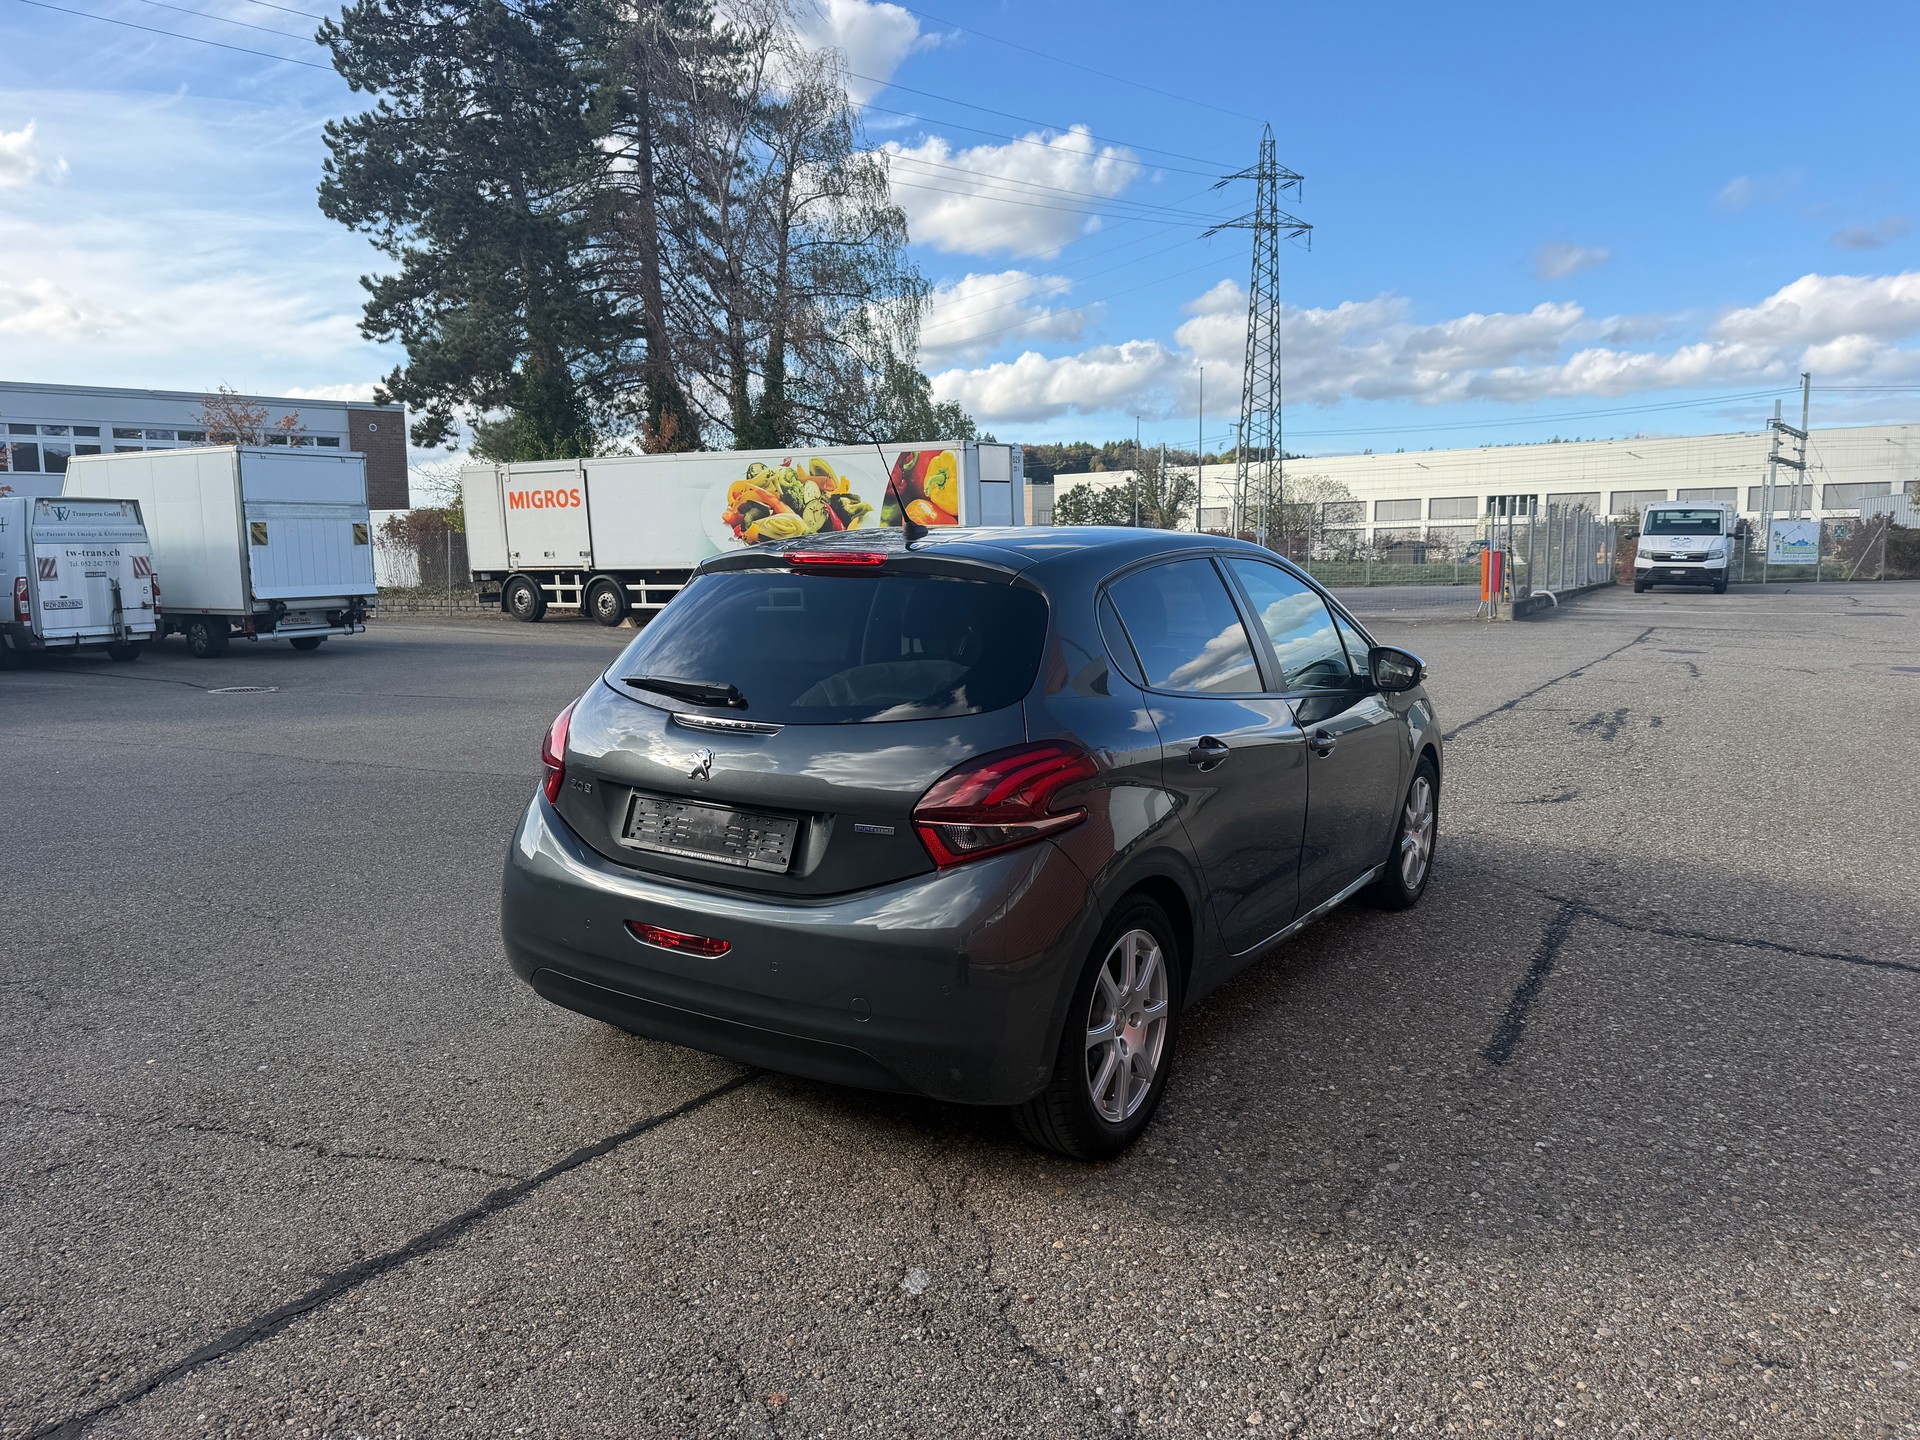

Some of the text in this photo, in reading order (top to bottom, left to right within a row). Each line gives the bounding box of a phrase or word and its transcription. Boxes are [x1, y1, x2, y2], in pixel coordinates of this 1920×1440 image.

[508, 488, 582, 510] MIGROS
[72, 510, 103, 519] Transporte
[103, 510, 122, 518] GmbH
[65, 548, 121, 558] tw-trans.ch
[80, 560, 92, 568] 052
[142, 586, 149, 595] 5
[570, 777, 593, 795] 208
